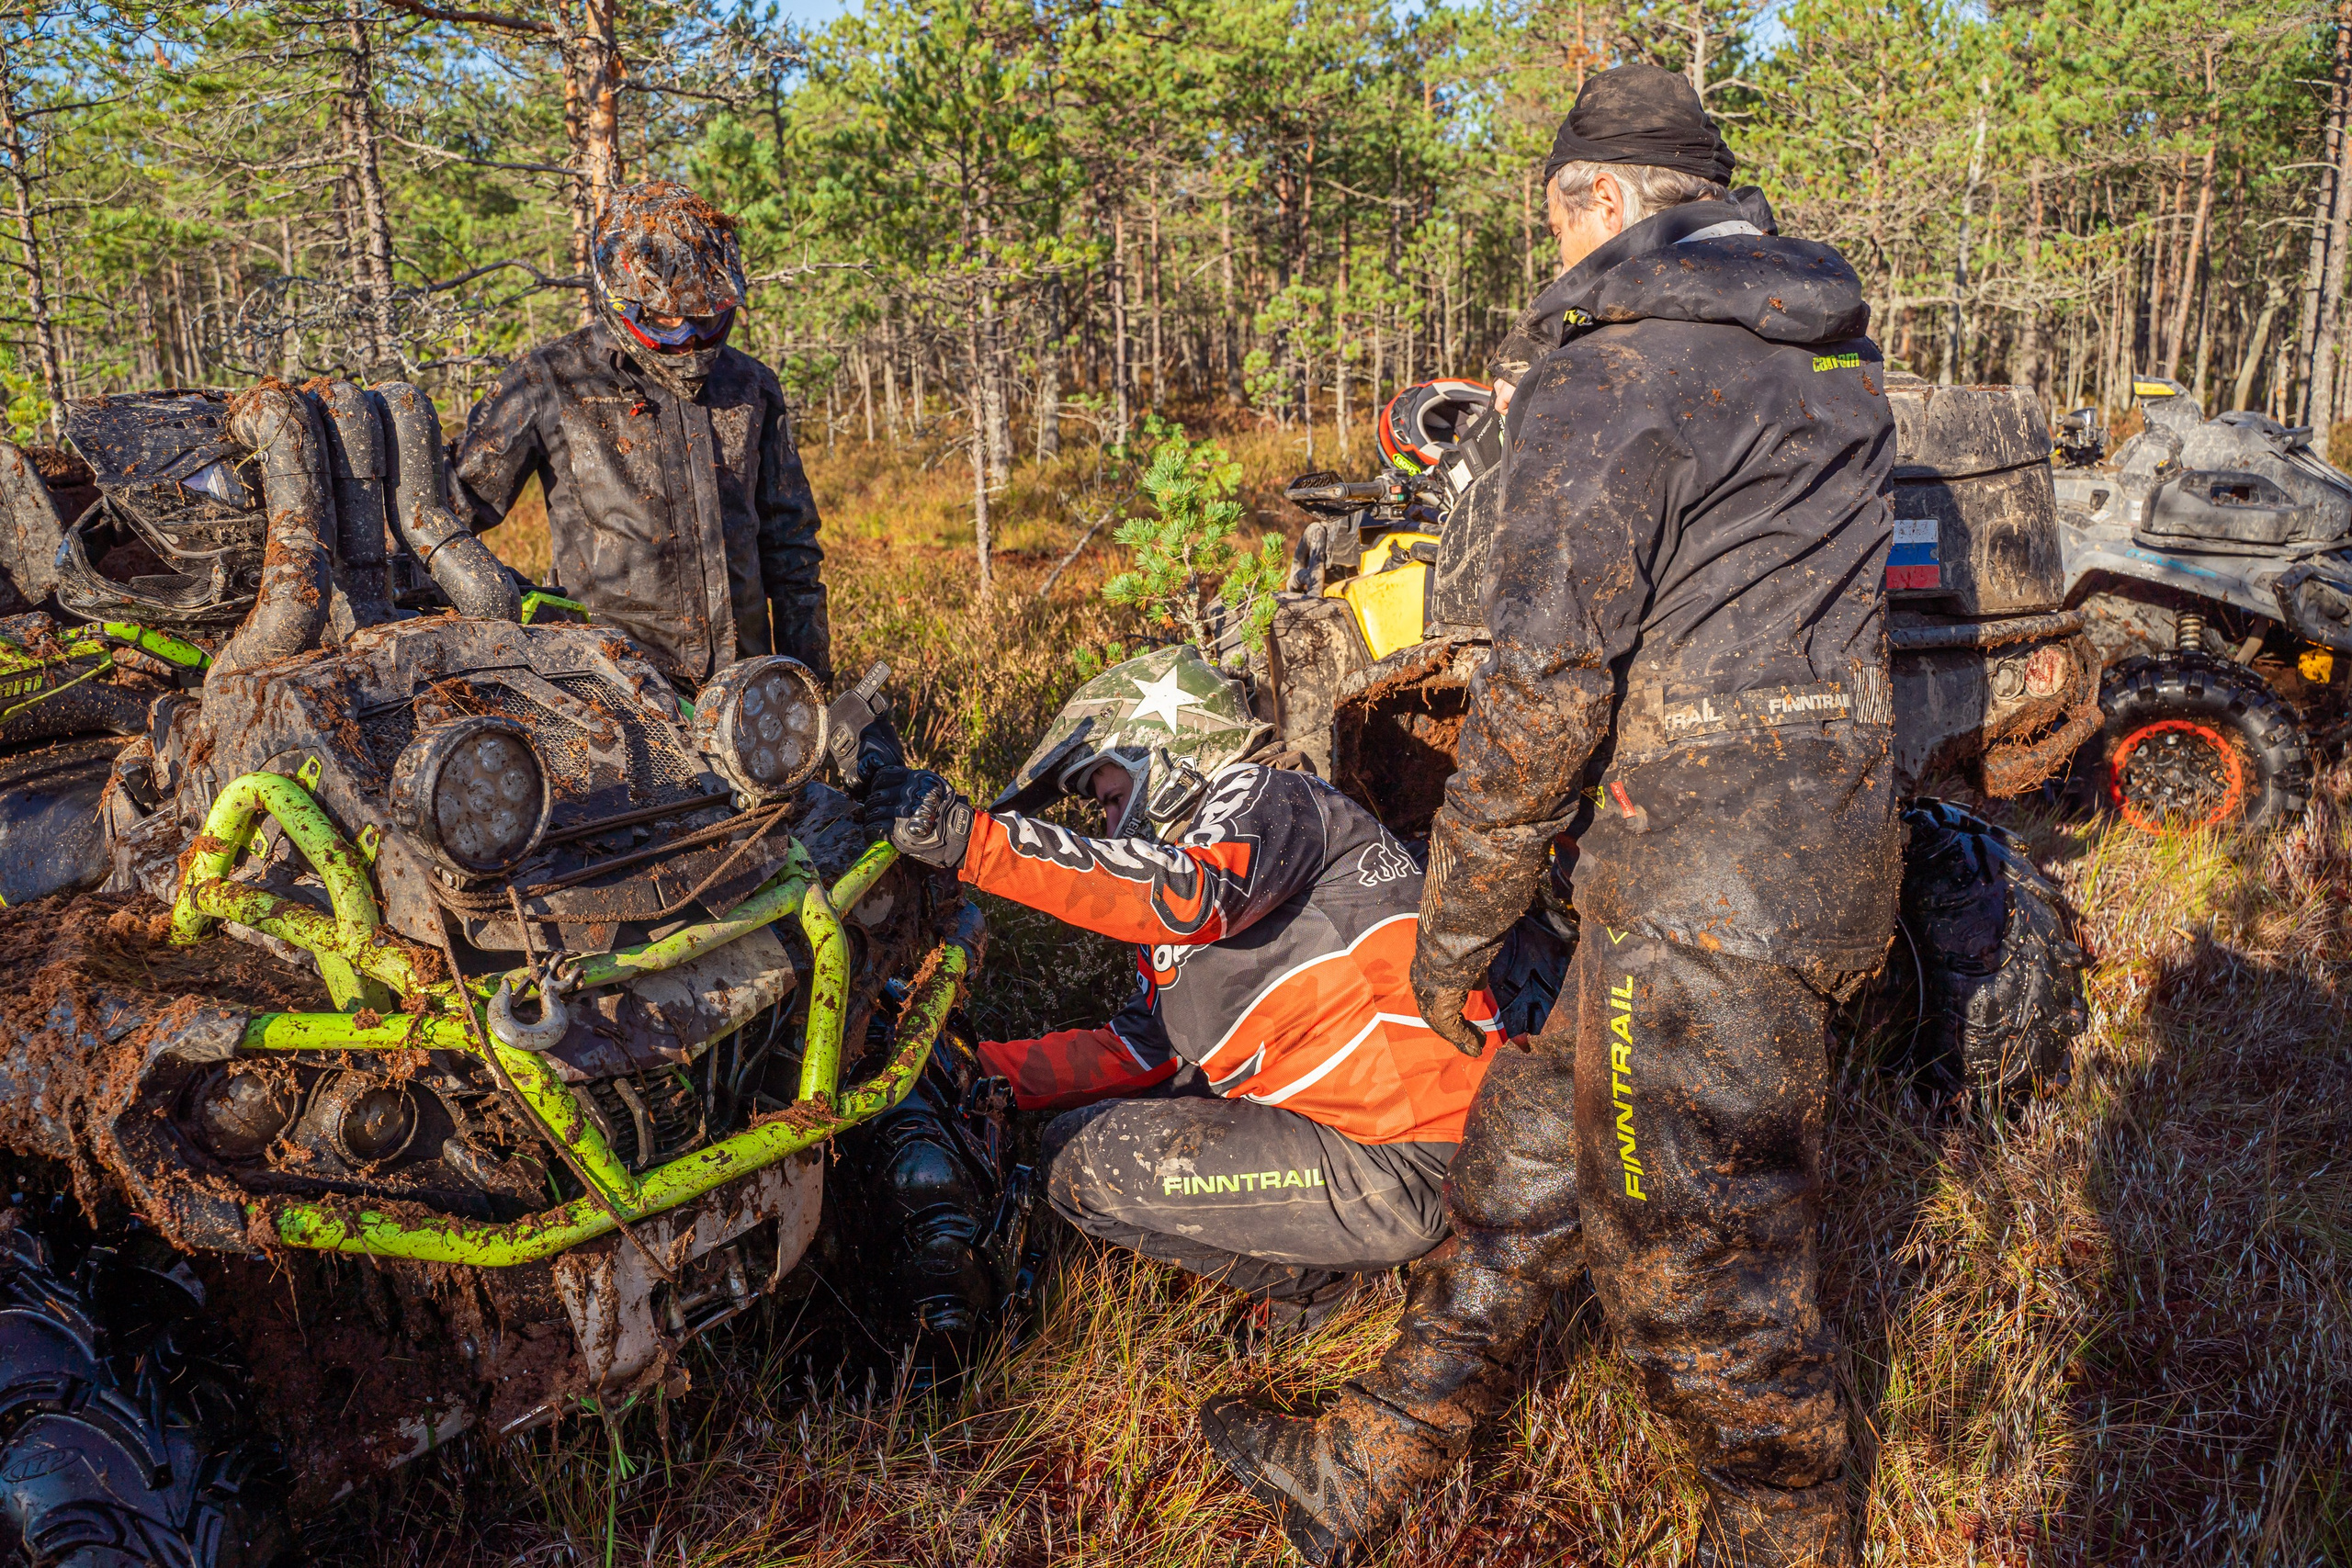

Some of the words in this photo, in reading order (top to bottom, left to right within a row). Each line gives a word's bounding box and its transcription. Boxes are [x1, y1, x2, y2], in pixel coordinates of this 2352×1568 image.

[856, 663, 882, 694] ASPOLIFE
[1123, 817, 1142, 839] ICO
[1611, 976, 1647, 1201] FINNTRAIL
[1163, 1168, 1326, 1196] FINNTRAIL
